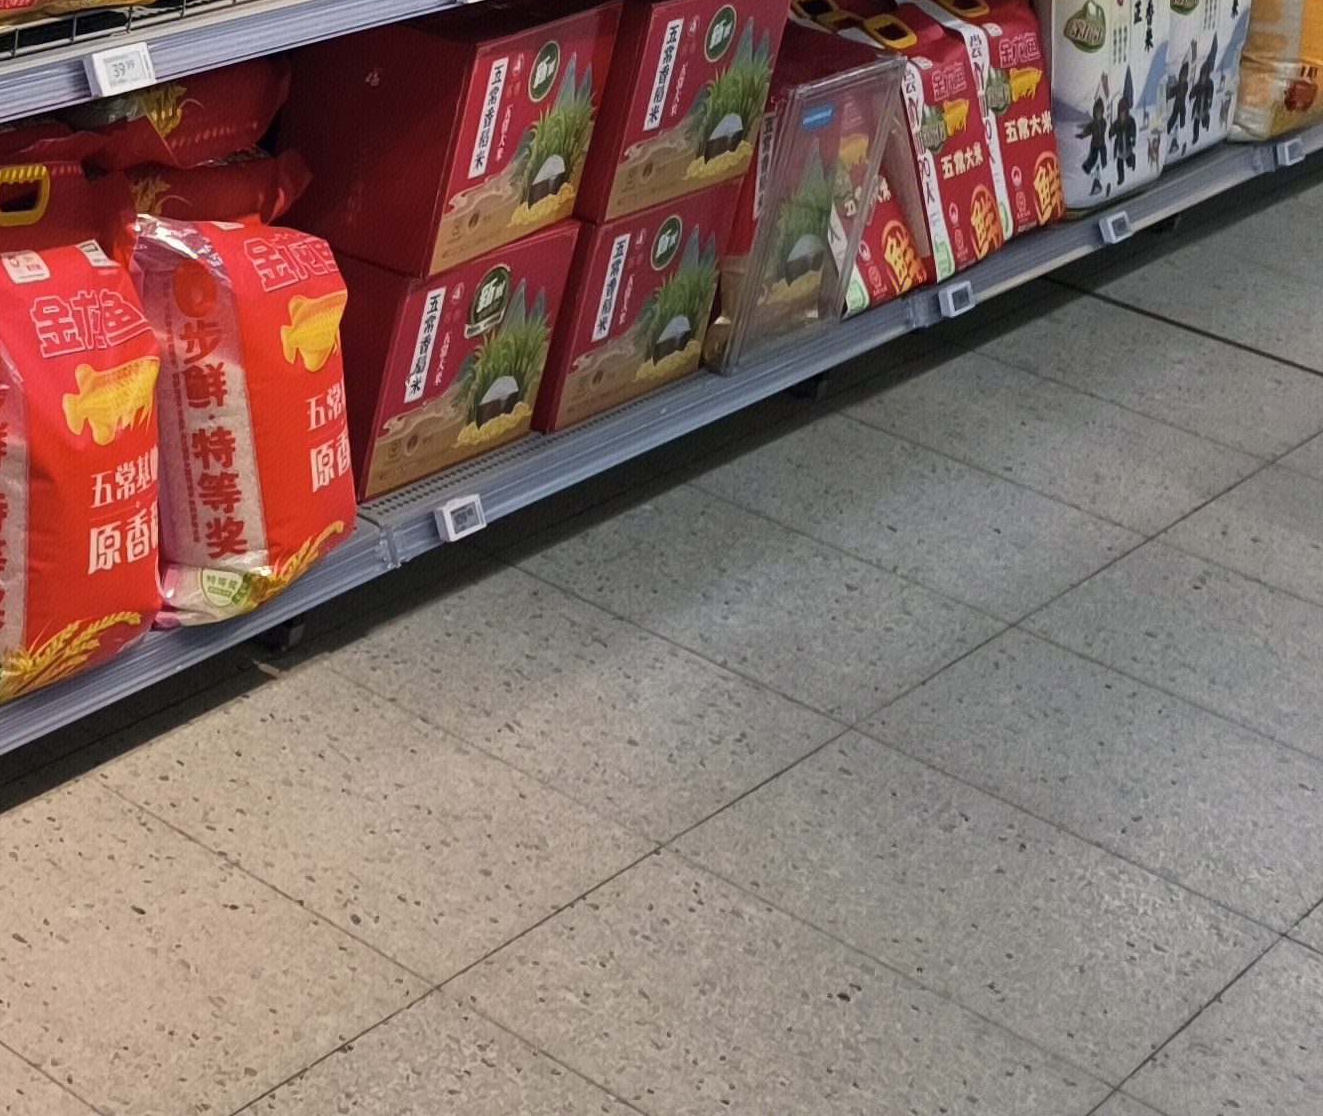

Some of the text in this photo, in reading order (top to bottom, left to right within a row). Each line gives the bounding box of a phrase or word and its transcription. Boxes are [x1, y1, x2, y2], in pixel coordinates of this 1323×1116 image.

[1004, 110, 1052, 143] 五常大米
[941, 142, 984, 180] 五常大米
[29, 289, 153, 358] 金龙鱼
[88, 509, 157, 576] 原香
